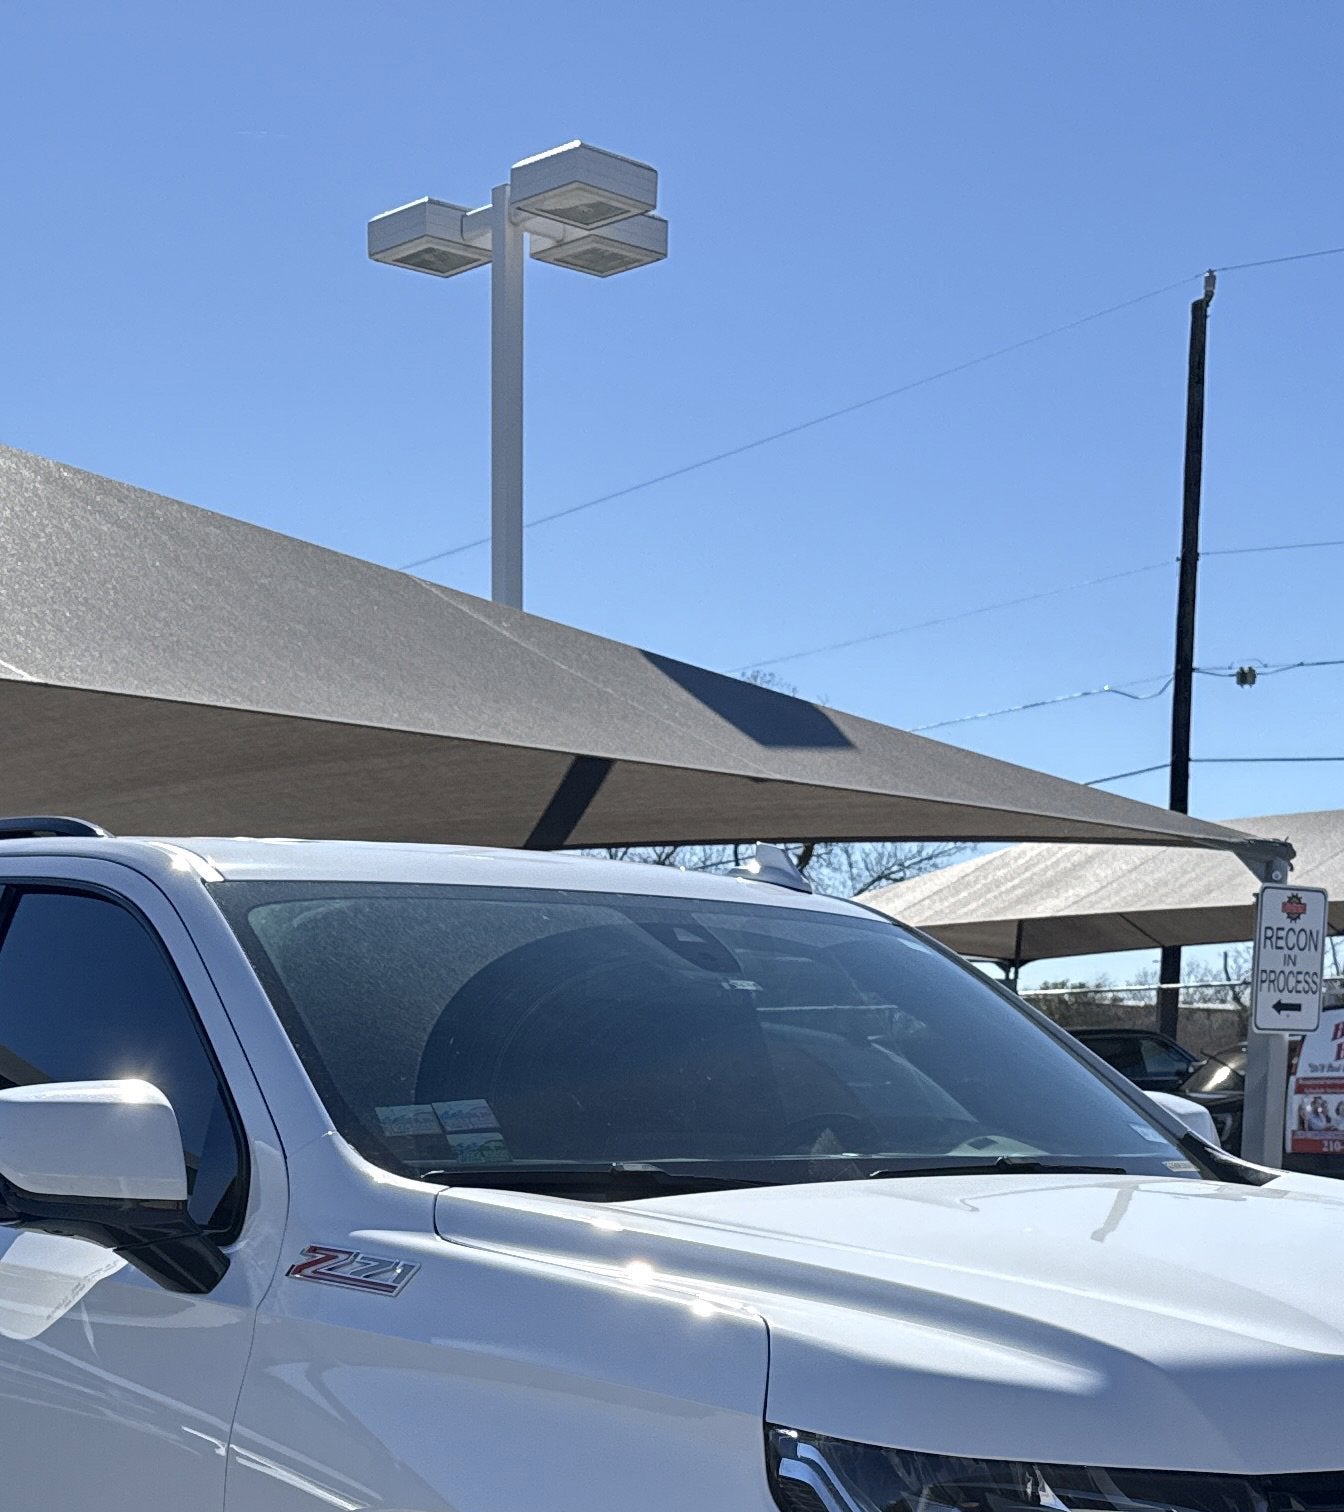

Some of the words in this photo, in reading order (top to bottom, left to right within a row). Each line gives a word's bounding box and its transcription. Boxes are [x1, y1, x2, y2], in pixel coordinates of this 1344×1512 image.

[1263, 926, 1320, 951] RECON
[1283, 954, 1298, 967] IN
[1259, 969, 1320, 995] PROCESS
[285, 1244, 422, 1297] Z71
